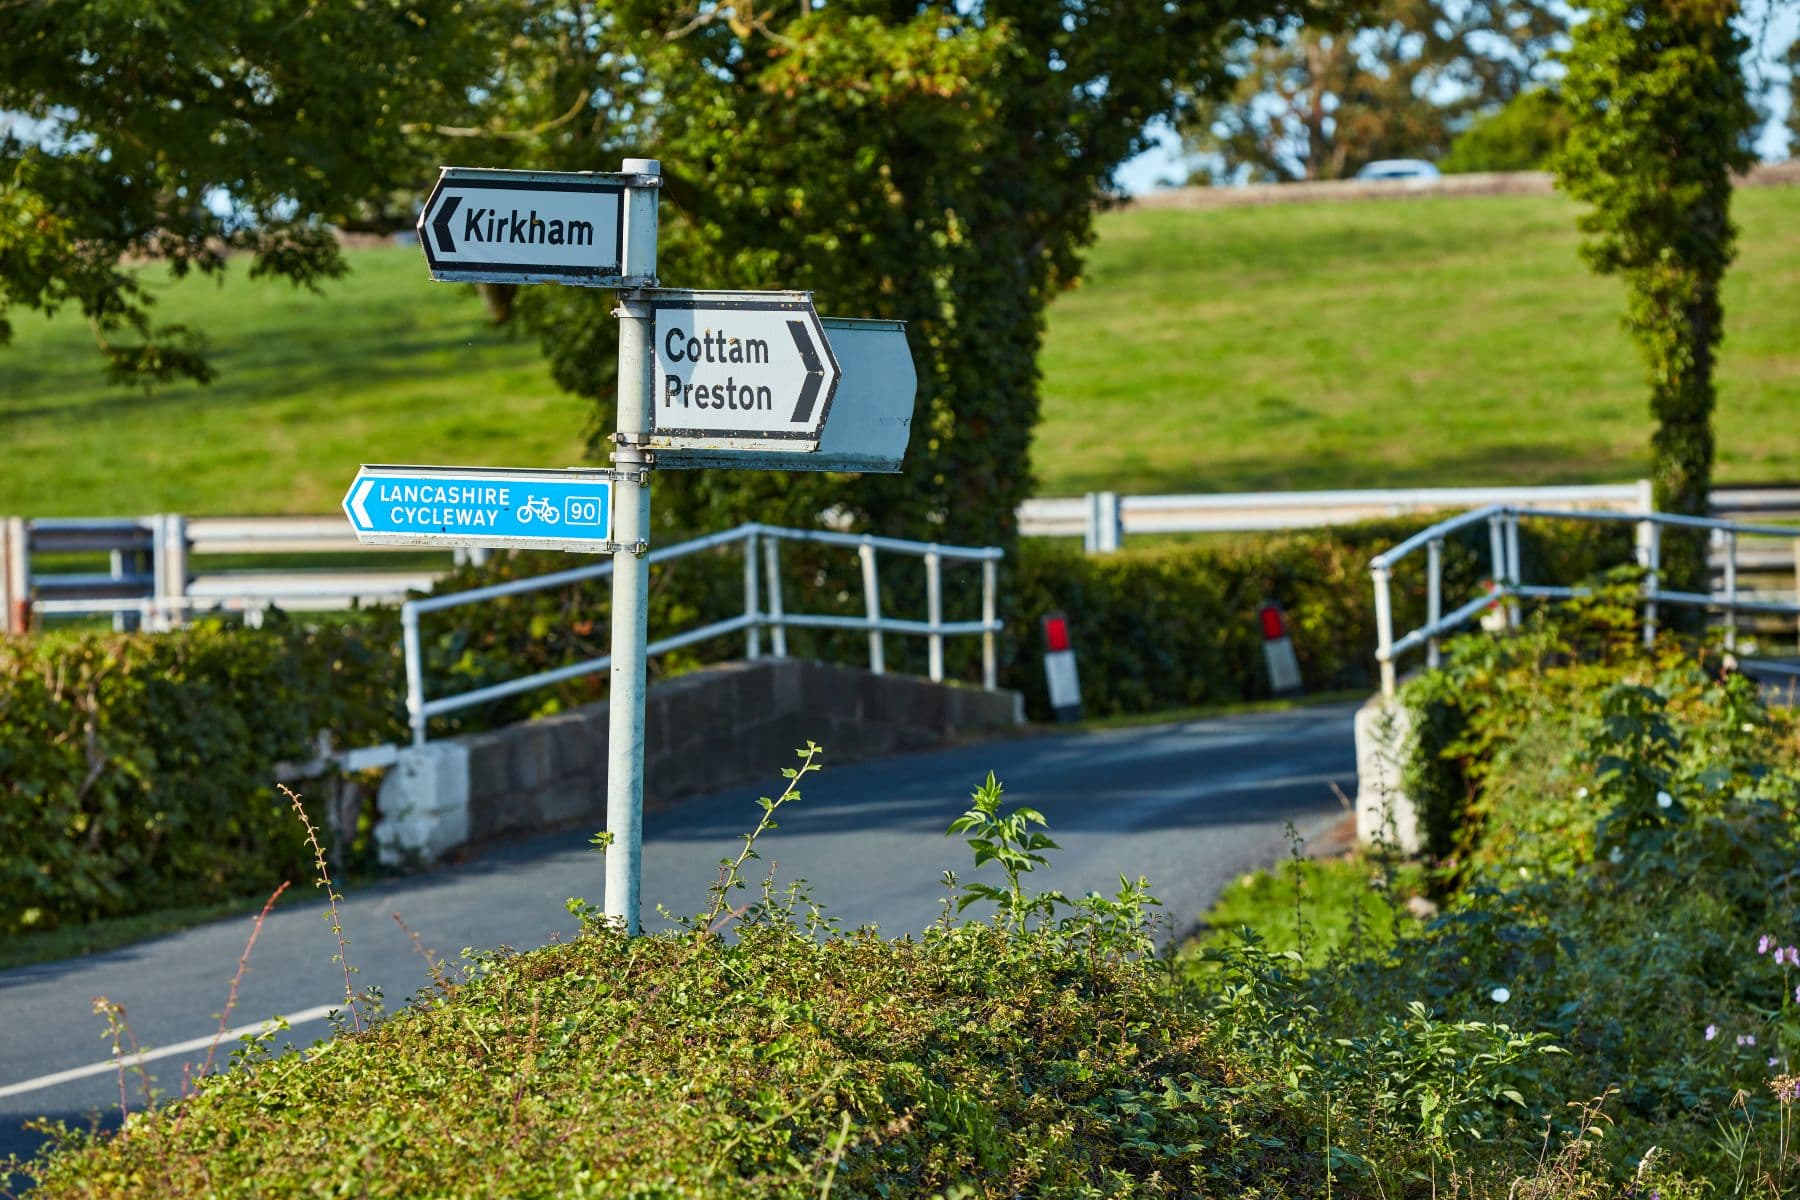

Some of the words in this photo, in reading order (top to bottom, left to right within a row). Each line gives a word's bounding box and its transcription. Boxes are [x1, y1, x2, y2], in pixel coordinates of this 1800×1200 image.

[464, 208, 594, 246] Kirkham
[665, 327, 769, 364] Cottam
[665, 374, 772, 411] Preston
[380, 484, 510, 506] LANCASHIRE
[390, 507, 499, 527] CYCLEWAY
[570, 502, 597, 521] 90
